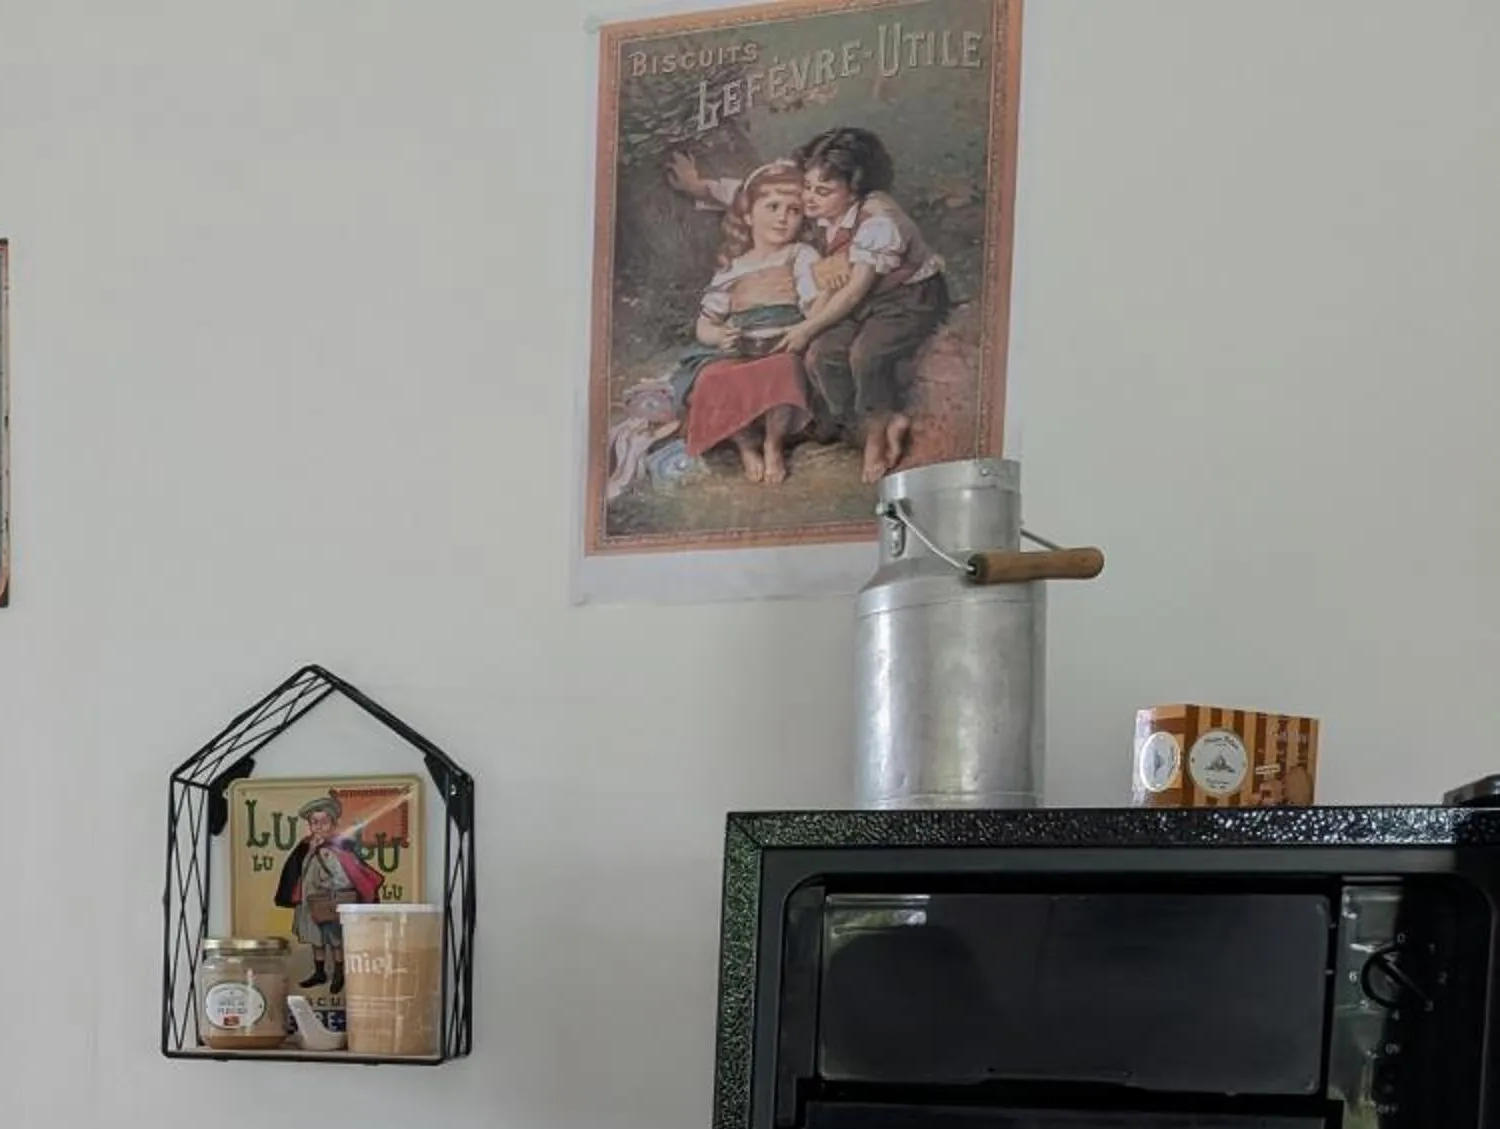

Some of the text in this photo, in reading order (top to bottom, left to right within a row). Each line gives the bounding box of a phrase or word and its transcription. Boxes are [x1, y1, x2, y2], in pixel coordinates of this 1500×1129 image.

[629, 42, 759, 77] BISCUITS
[244, 799, 299, 852] LU
[252, 853, 275, 873] LU
